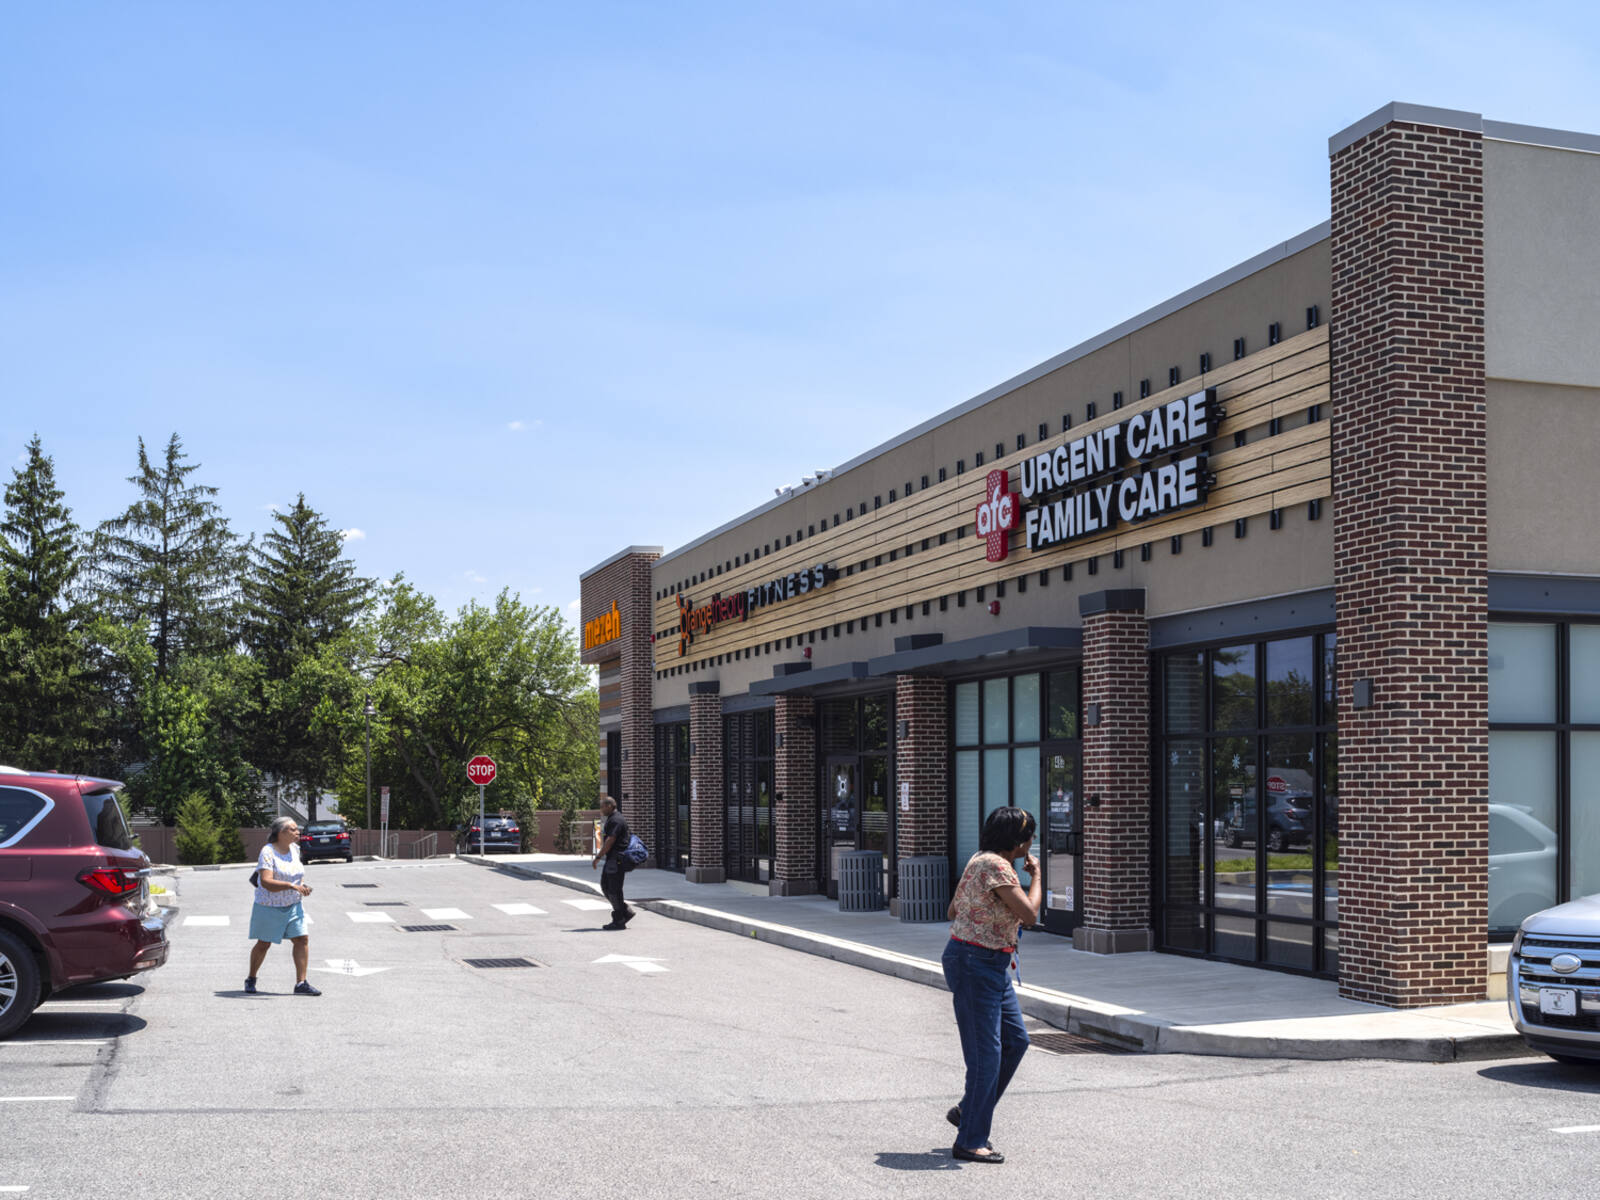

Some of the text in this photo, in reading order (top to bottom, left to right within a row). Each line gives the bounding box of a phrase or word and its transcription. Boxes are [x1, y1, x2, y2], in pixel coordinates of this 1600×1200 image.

[1020, 390, 1208, 498] URGENT CARE
[977, 485, 1011, 535] afc
[1026, 456, 1198, 549] FAMILY CARE
[747, 563, 825, 612] FITNESS
[585, 600, 621, 649] mezeh
[469, 765, 495, 776] STOP
